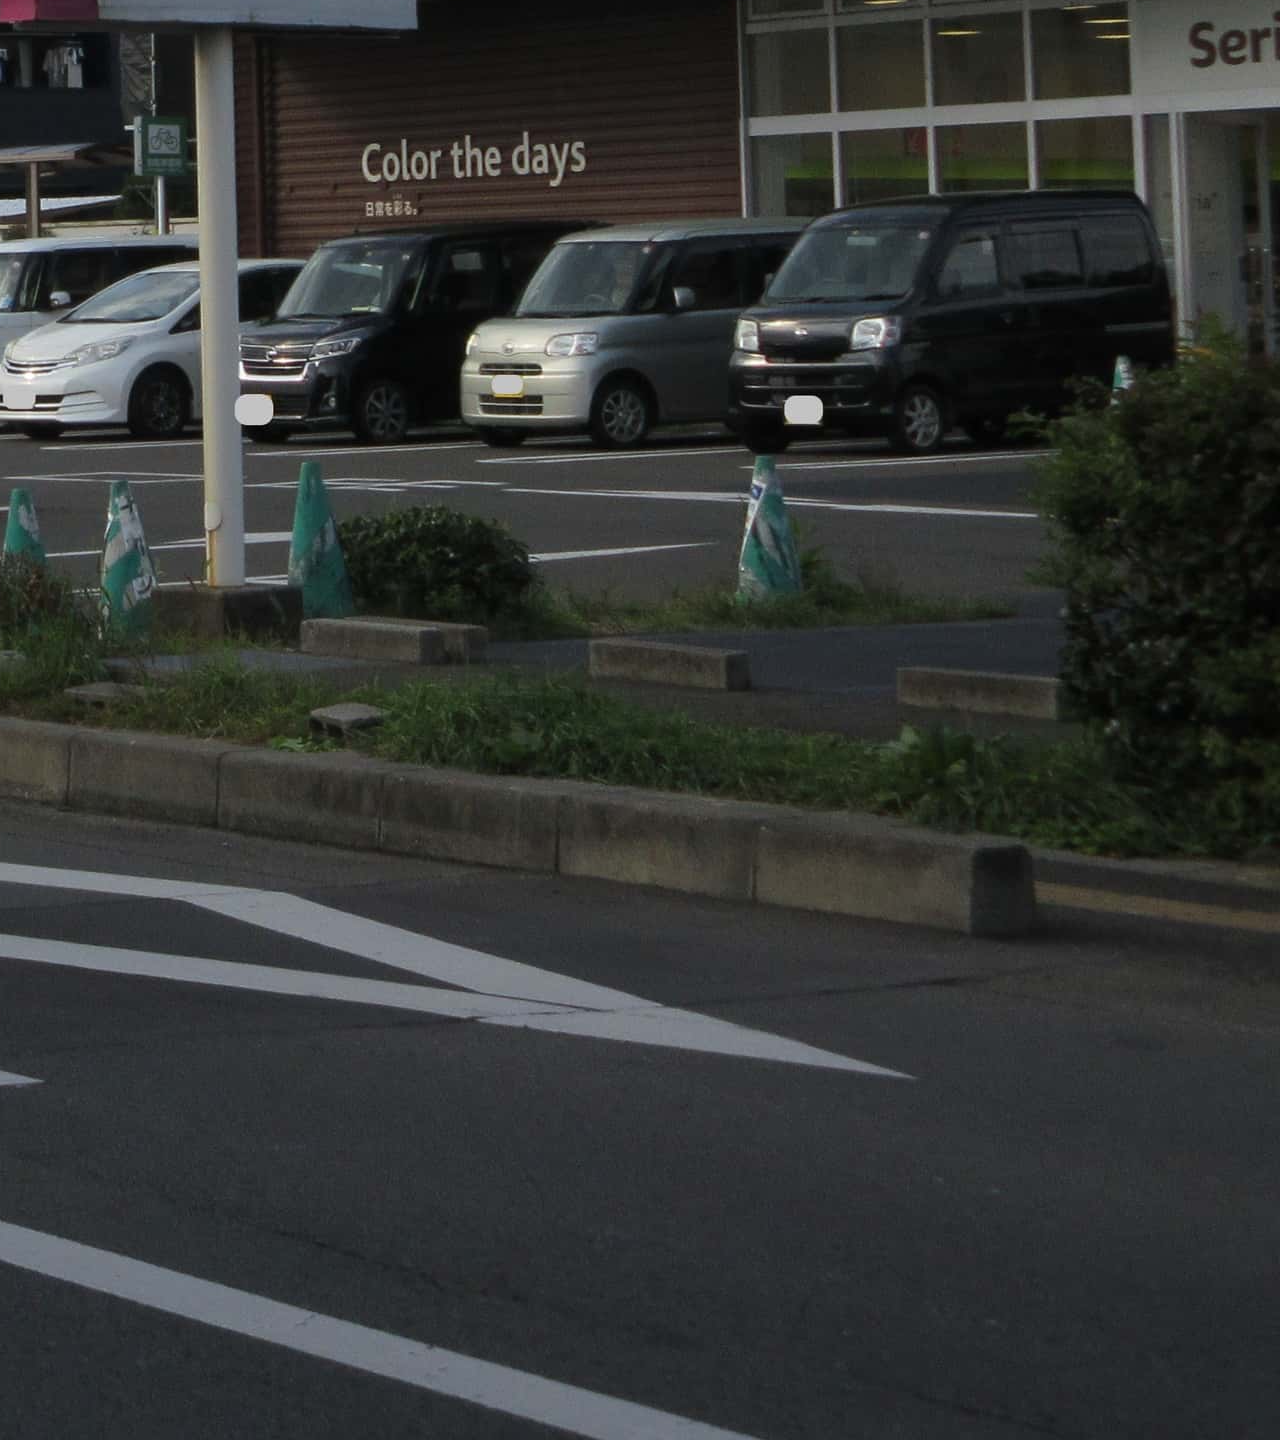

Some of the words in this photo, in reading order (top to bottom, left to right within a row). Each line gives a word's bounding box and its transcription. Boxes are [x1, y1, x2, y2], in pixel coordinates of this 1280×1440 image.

[361, 137, 442, 184] Color
[450, 134, 502, 180] the
[511, 130, 587, 188] days
